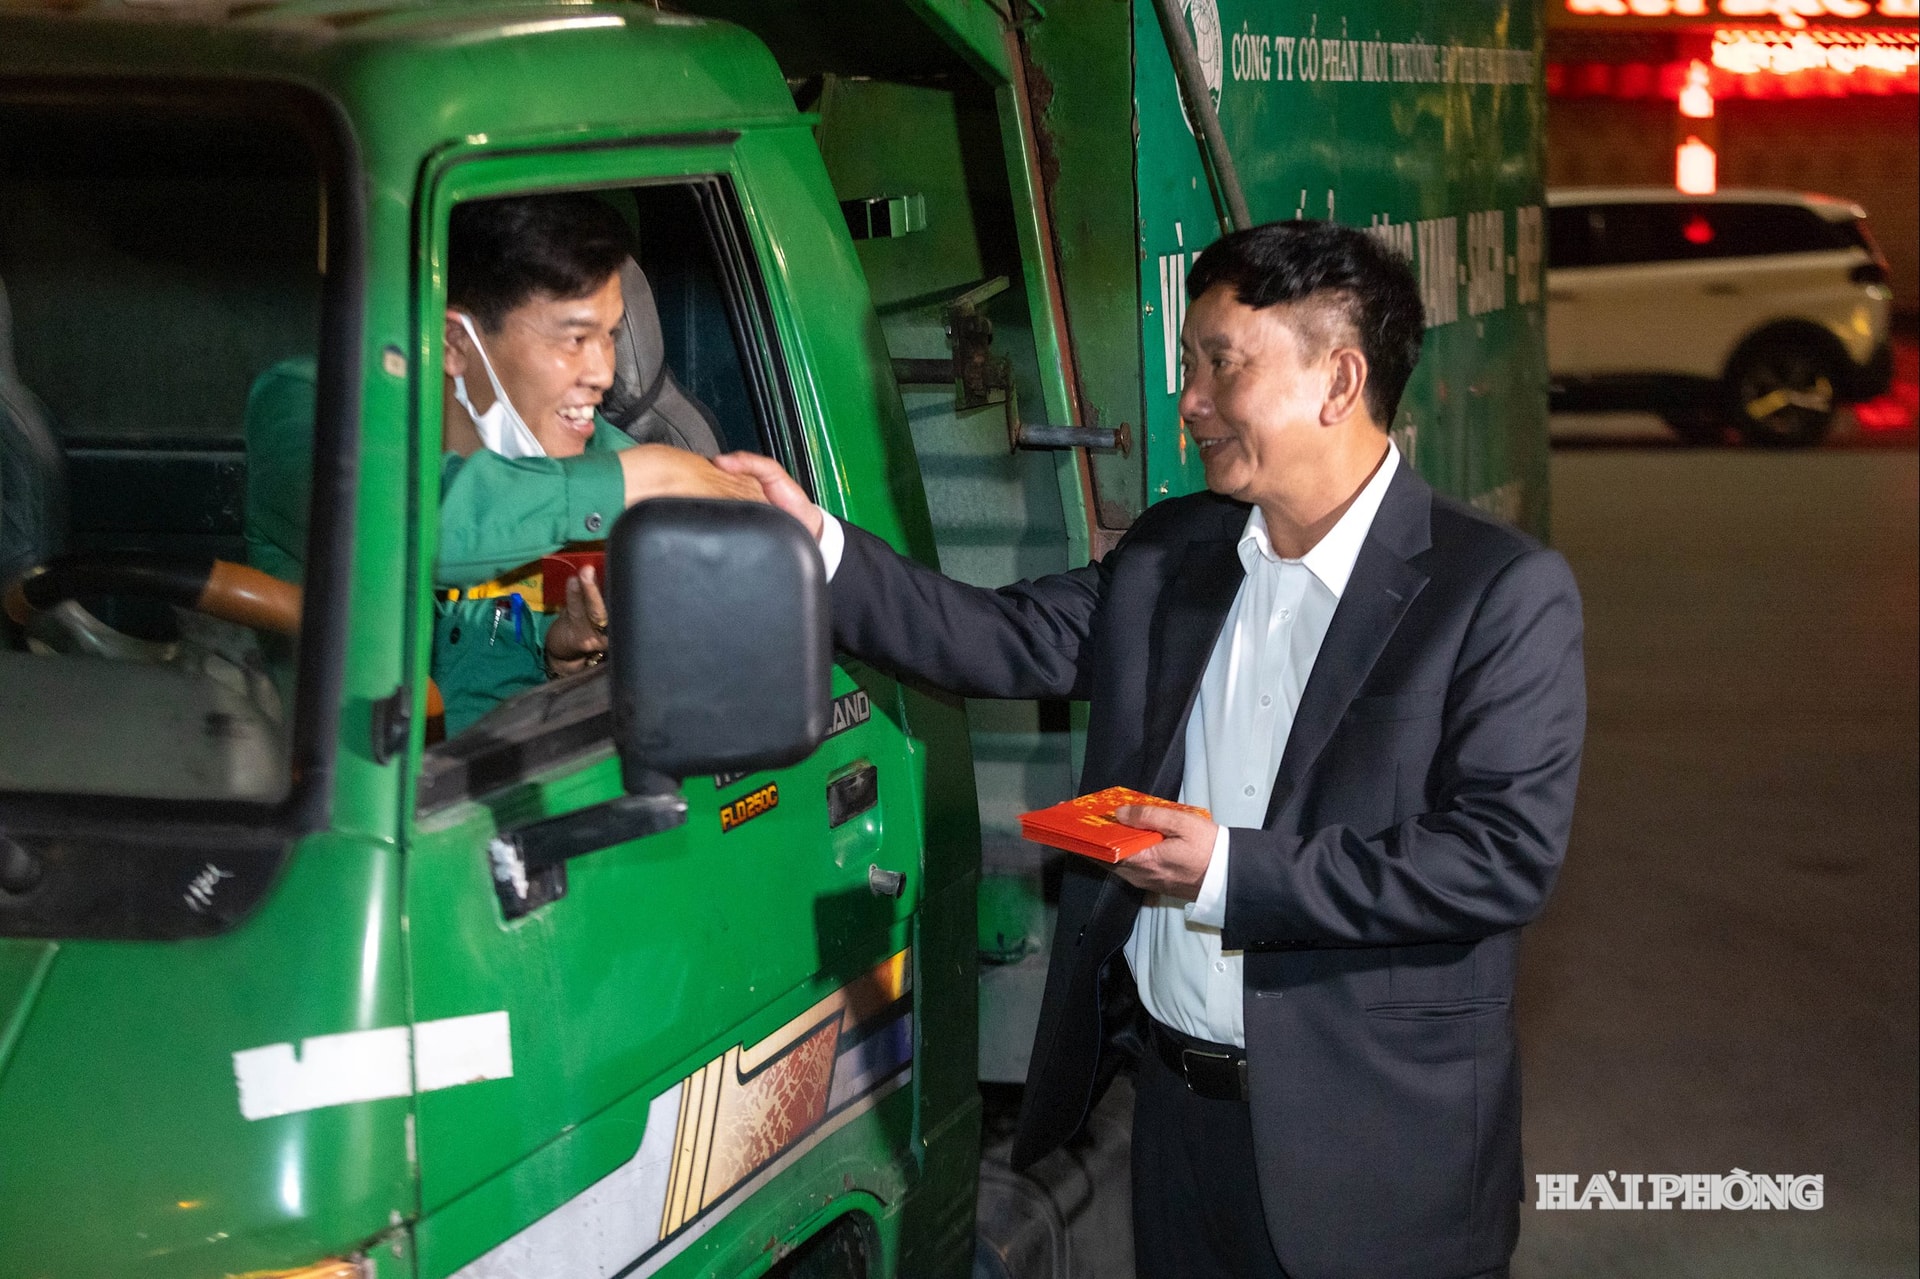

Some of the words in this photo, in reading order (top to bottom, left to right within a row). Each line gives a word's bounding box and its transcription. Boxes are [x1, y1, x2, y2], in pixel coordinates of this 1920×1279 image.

[1232, 19, 1271, 82] CÔNG
[1275, 35, 1296, 82] TY
[1298, 13, 1319, 82] CỔ
